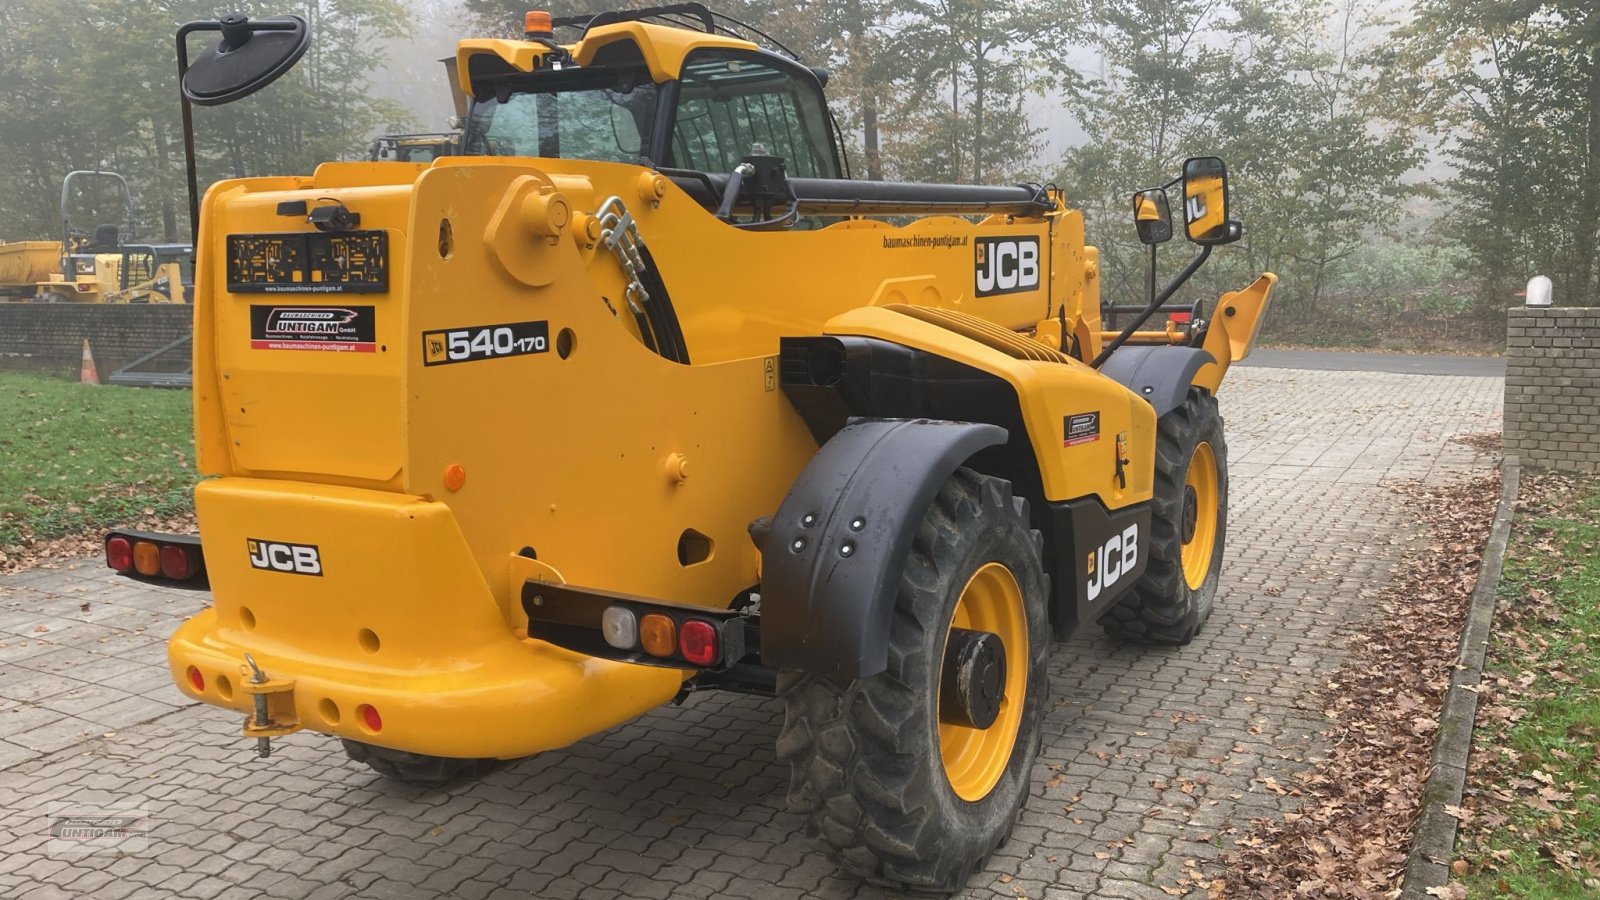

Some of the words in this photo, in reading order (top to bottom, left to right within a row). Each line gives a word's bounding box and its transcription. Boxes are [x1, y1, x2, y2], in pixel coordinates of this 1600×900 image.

[883, 234, 968, 249] baumaschinen-puntigam.at
[976, 241, 1038, 291] JCB
[269, 342, 355, 351] www.baumaschinen-puntigam.at
[250, 542, 320, 573] JCB
[1087, 523, 1138, 601] JCB
